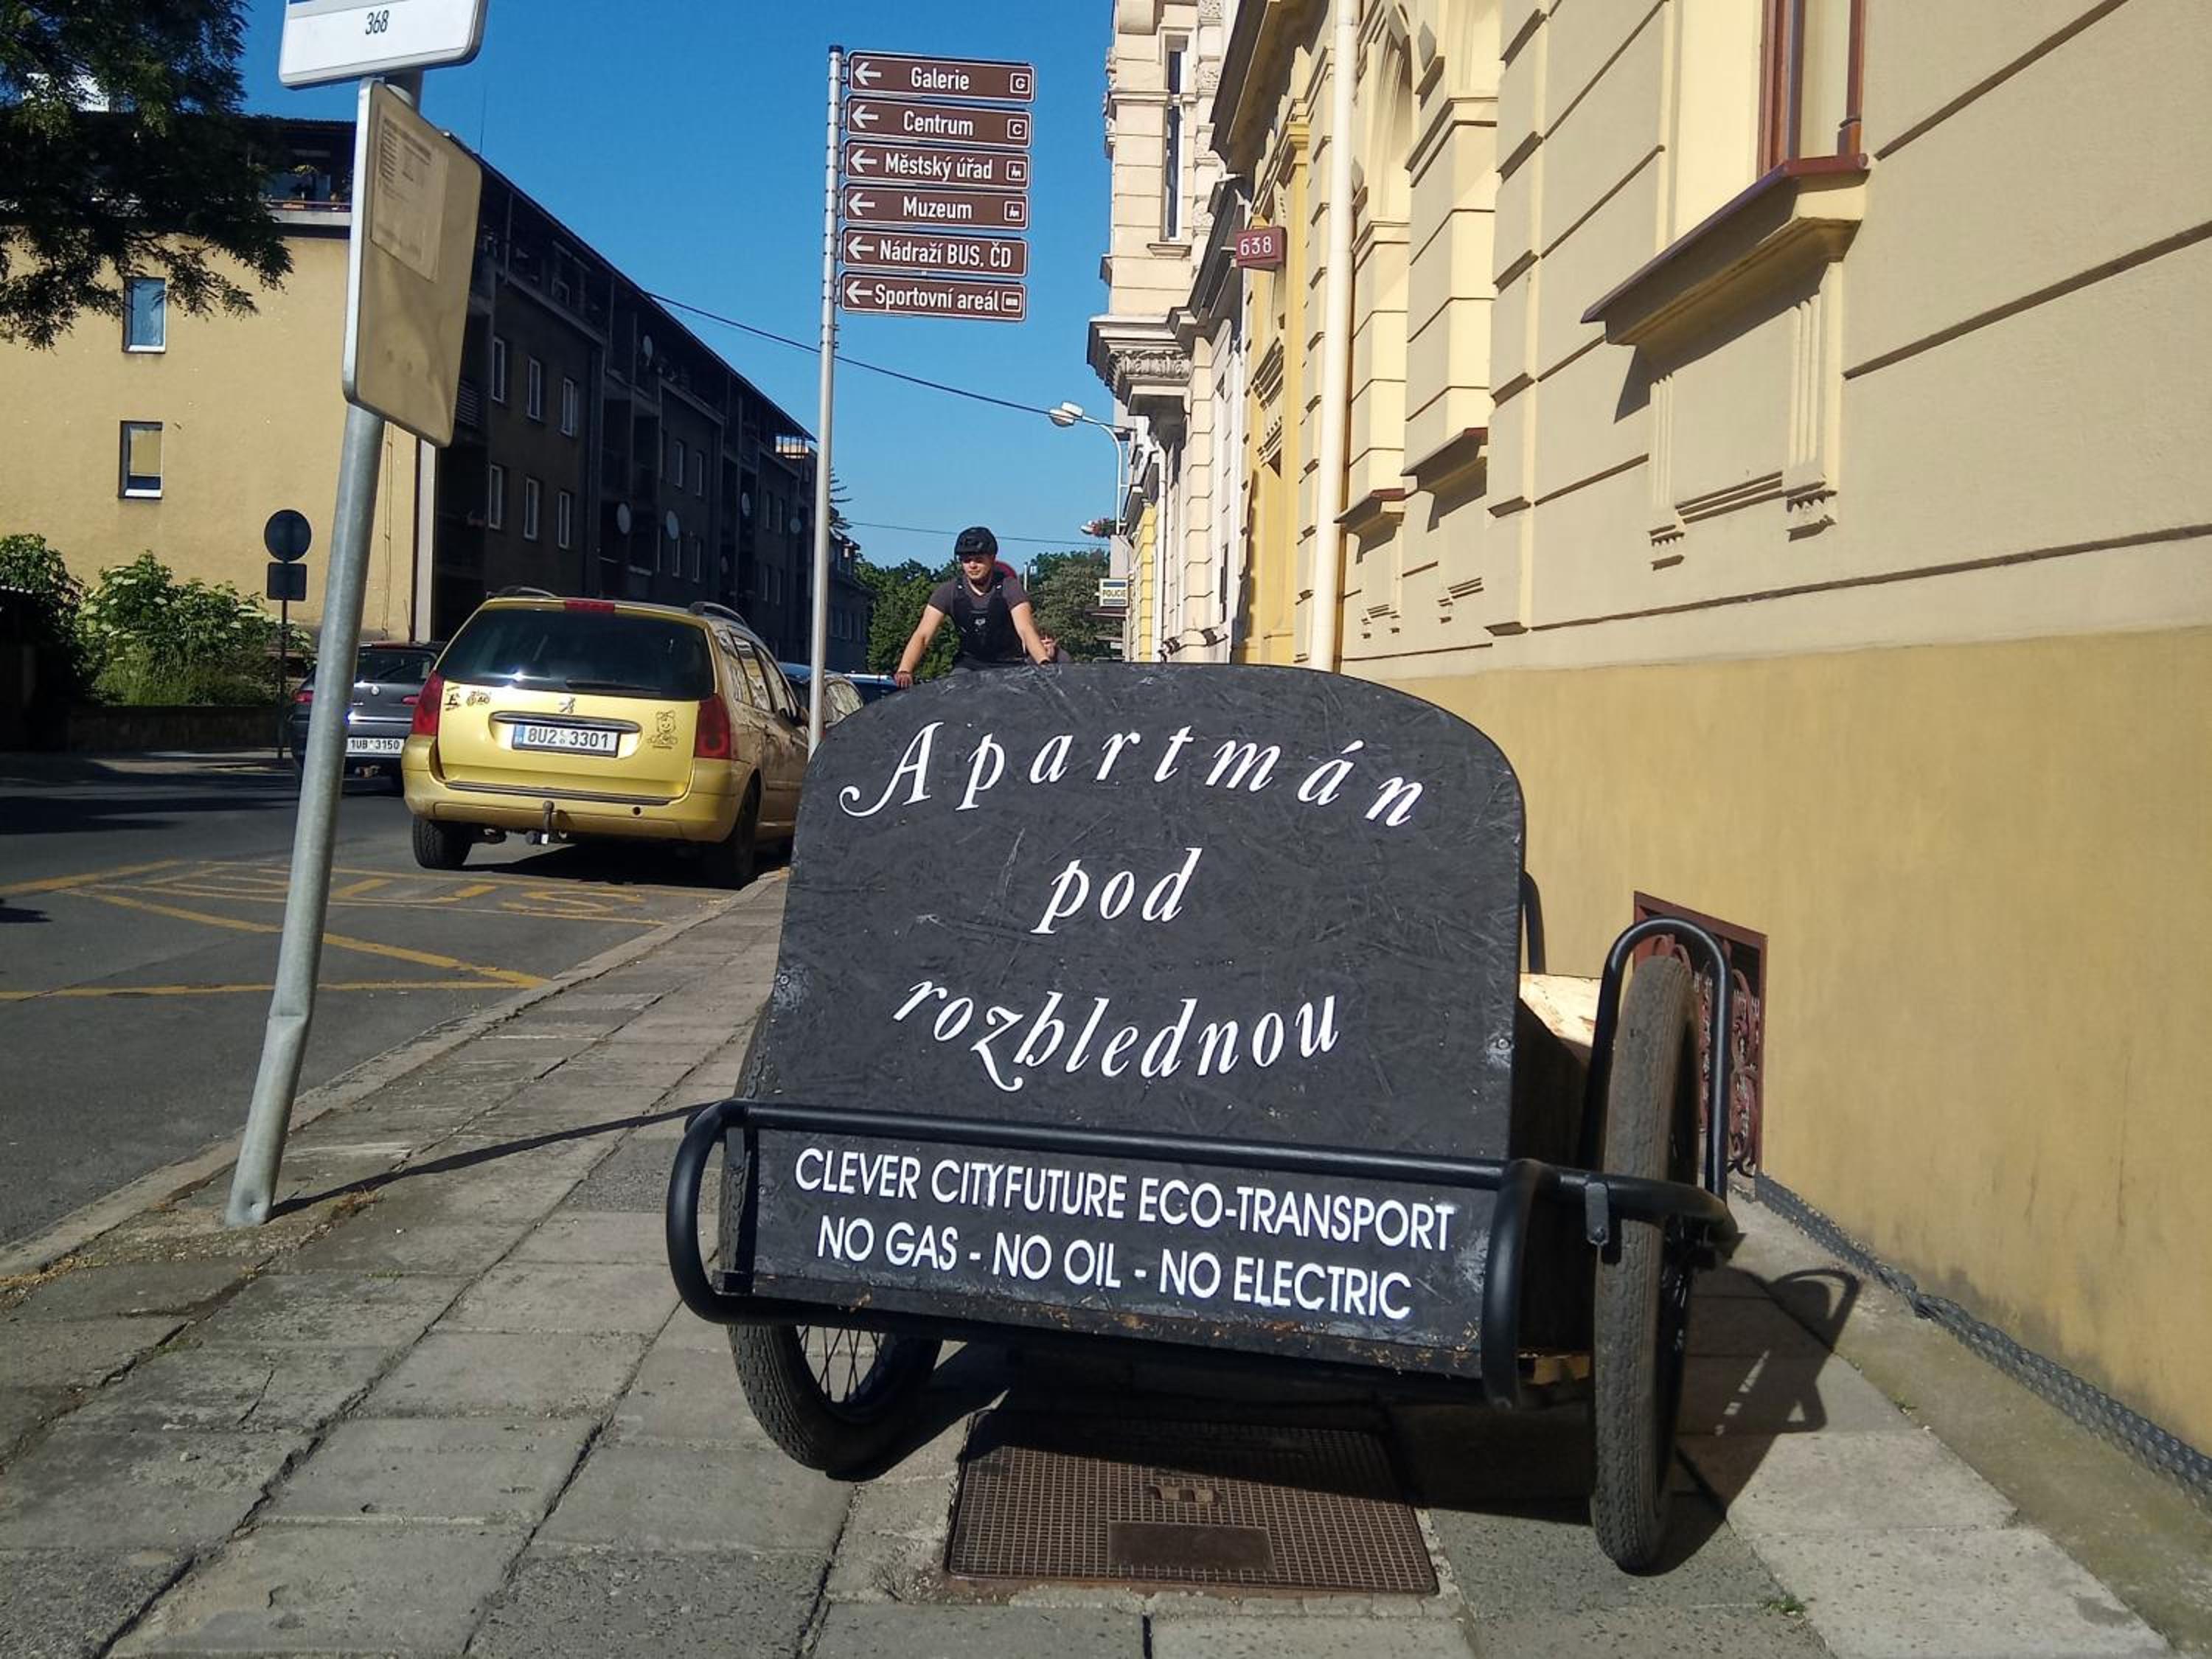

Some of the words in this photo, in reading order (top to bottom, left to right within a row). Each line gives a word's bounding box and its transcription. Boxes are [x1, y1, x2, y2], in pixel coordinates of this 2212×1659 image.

[365, 10, 389, 35] 368
[910, 66, 970, 91] Galerie
[903, 110, 974, 136] Centrum
[885, 153, 952, 182] Městský
[956, 155, 993, 180] úřad
[902, 195, 973, 220] Muzeum
[880, 239, 942, 264] Nádraží
[947, 244, 984, 268] BUS.
[990, 241, 1012, 268] ČD
[1240, 235, 1272, 256] 638
[874, 283, 953, 310] Sportovní
[957, 291, 999, 312] areál
[375, 740, 400, 751] 3150
[527, 728, 558, 745] 8U2
[568, 731, 609, 748] 3301
[838, 722, 1425, 827] Apartmán
[1030, 847, 1203, 934] pod
[893, 979, 1340, 1091] rozblednou
[795, 1147, 921, 1200] CLEVER
[931, 1159, 1128, 1220] CITYFUTURE
[1138, 1177, 1455, 1251] ECO-TRANSPORT
[817, 1214, 875, 1262] NO
[885, 1221, 959, 1271] GAS
[992, 1231, 1053, 1281] NO
[1063, 1239, 1121, 1288] OIL
[1160, 1248, 1222, 1298] NO
[1233, 1256, 1412, 1320] ELECTRIC
